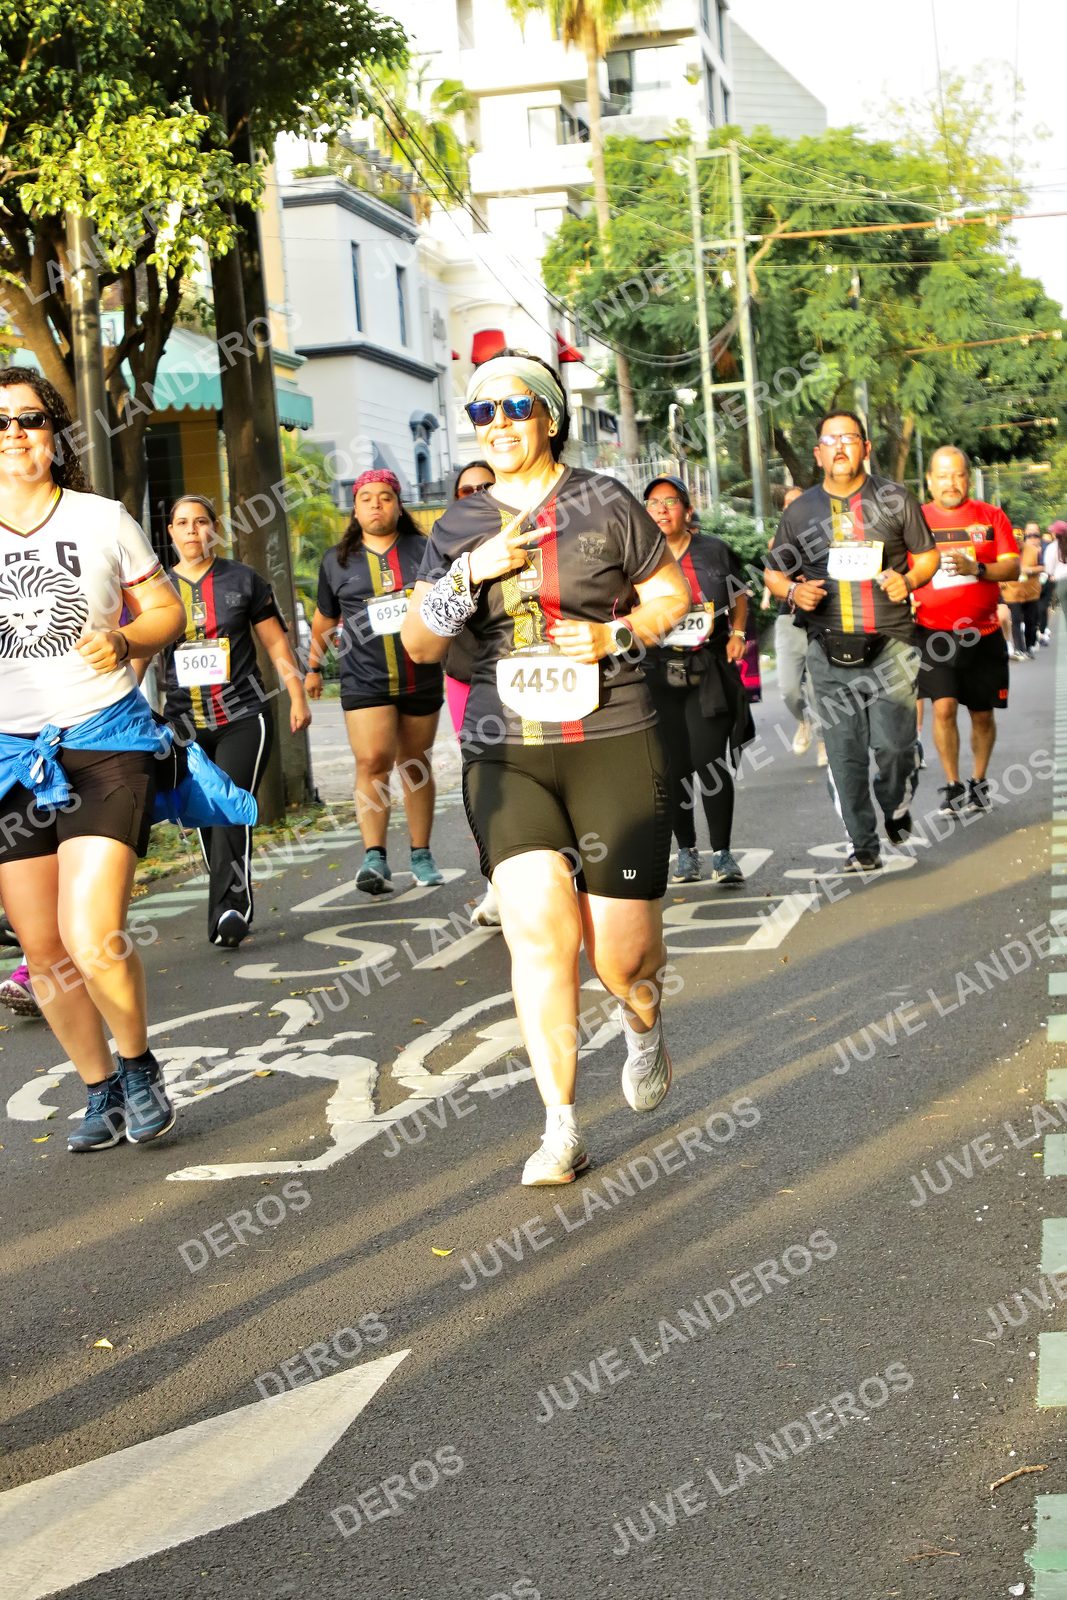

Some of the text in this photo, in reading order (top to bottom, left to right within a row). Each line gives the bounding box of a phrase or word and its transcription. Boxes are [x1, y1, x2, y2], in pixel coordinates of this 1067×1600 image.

[5, 541, 82, 578] DE G
[377, 603, 408, 621] 6954
[678, 617, 704, 631] 320
[182, 654, 218, 671] 5602
[510, 667, 577, 693] 4450
